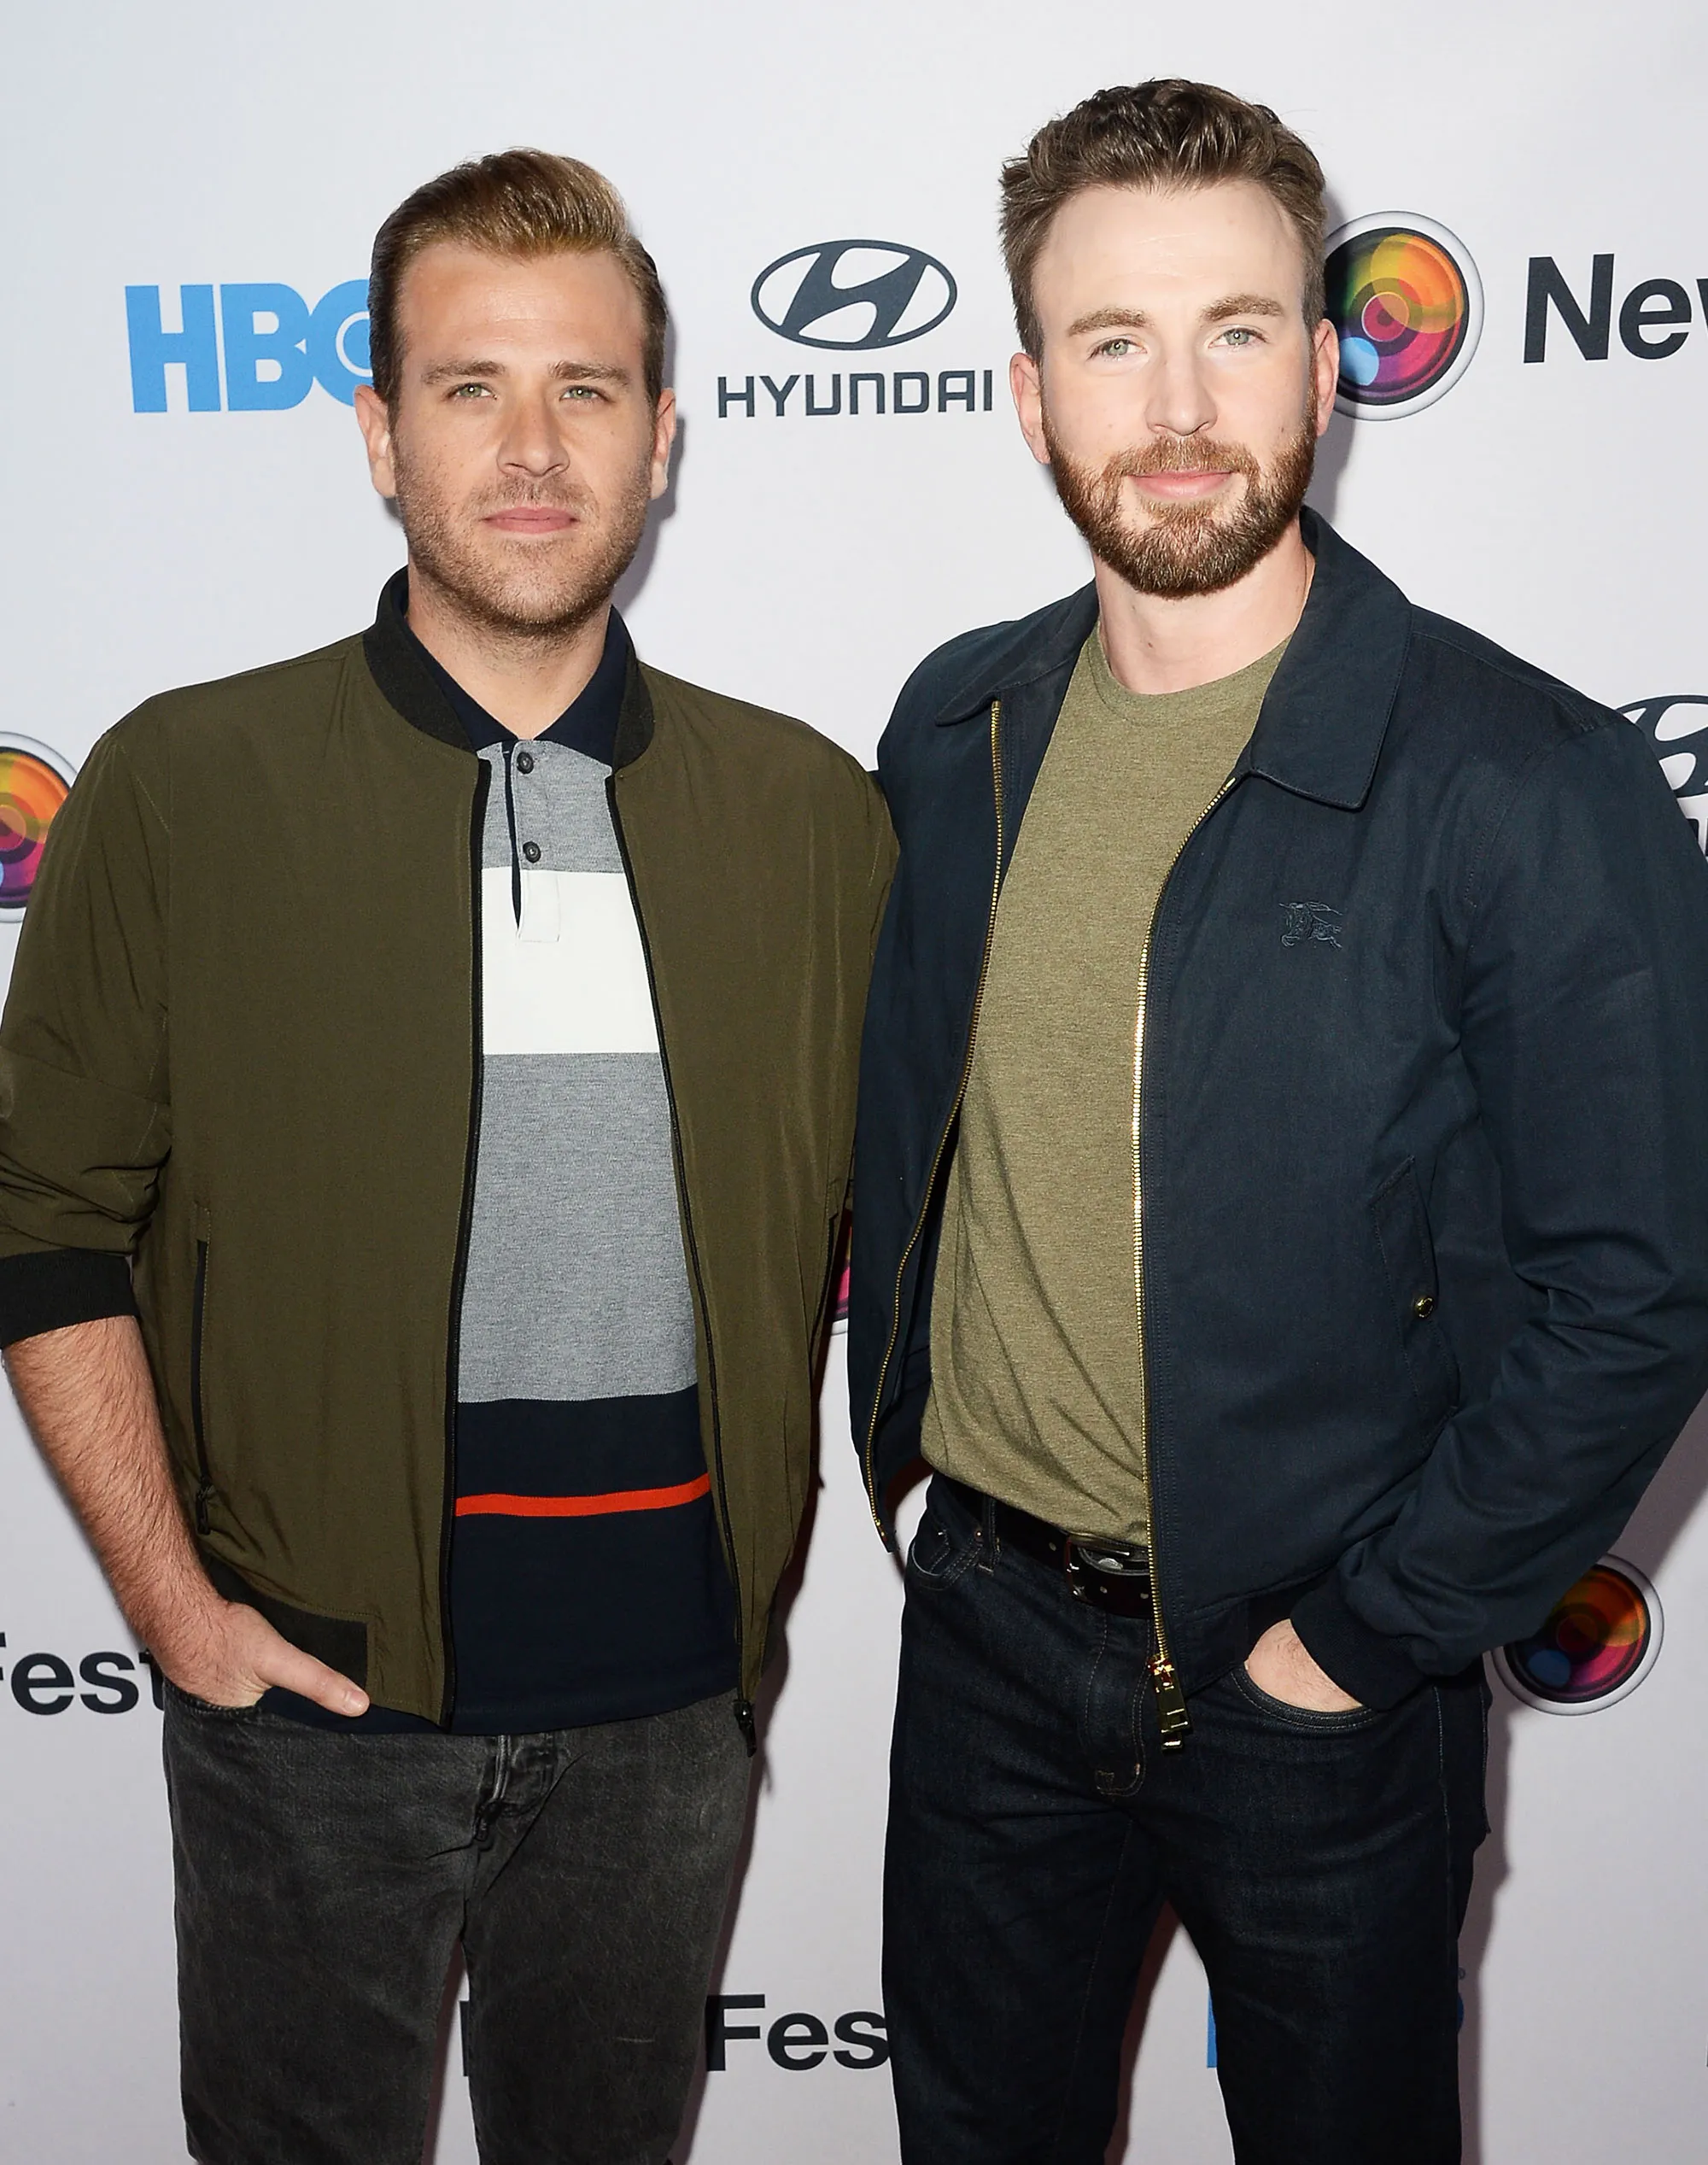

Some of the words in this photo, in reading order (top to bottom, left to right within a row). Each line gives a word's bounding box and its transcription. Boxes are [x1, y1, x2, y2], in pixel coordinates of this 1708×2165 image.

[1524, 253, 1708, 364] Ne
[717, 370, 992, 418] HYUNDAI
[0, 1632, 164, 1715] es
[705, 1994, 889, 2071] Fes
